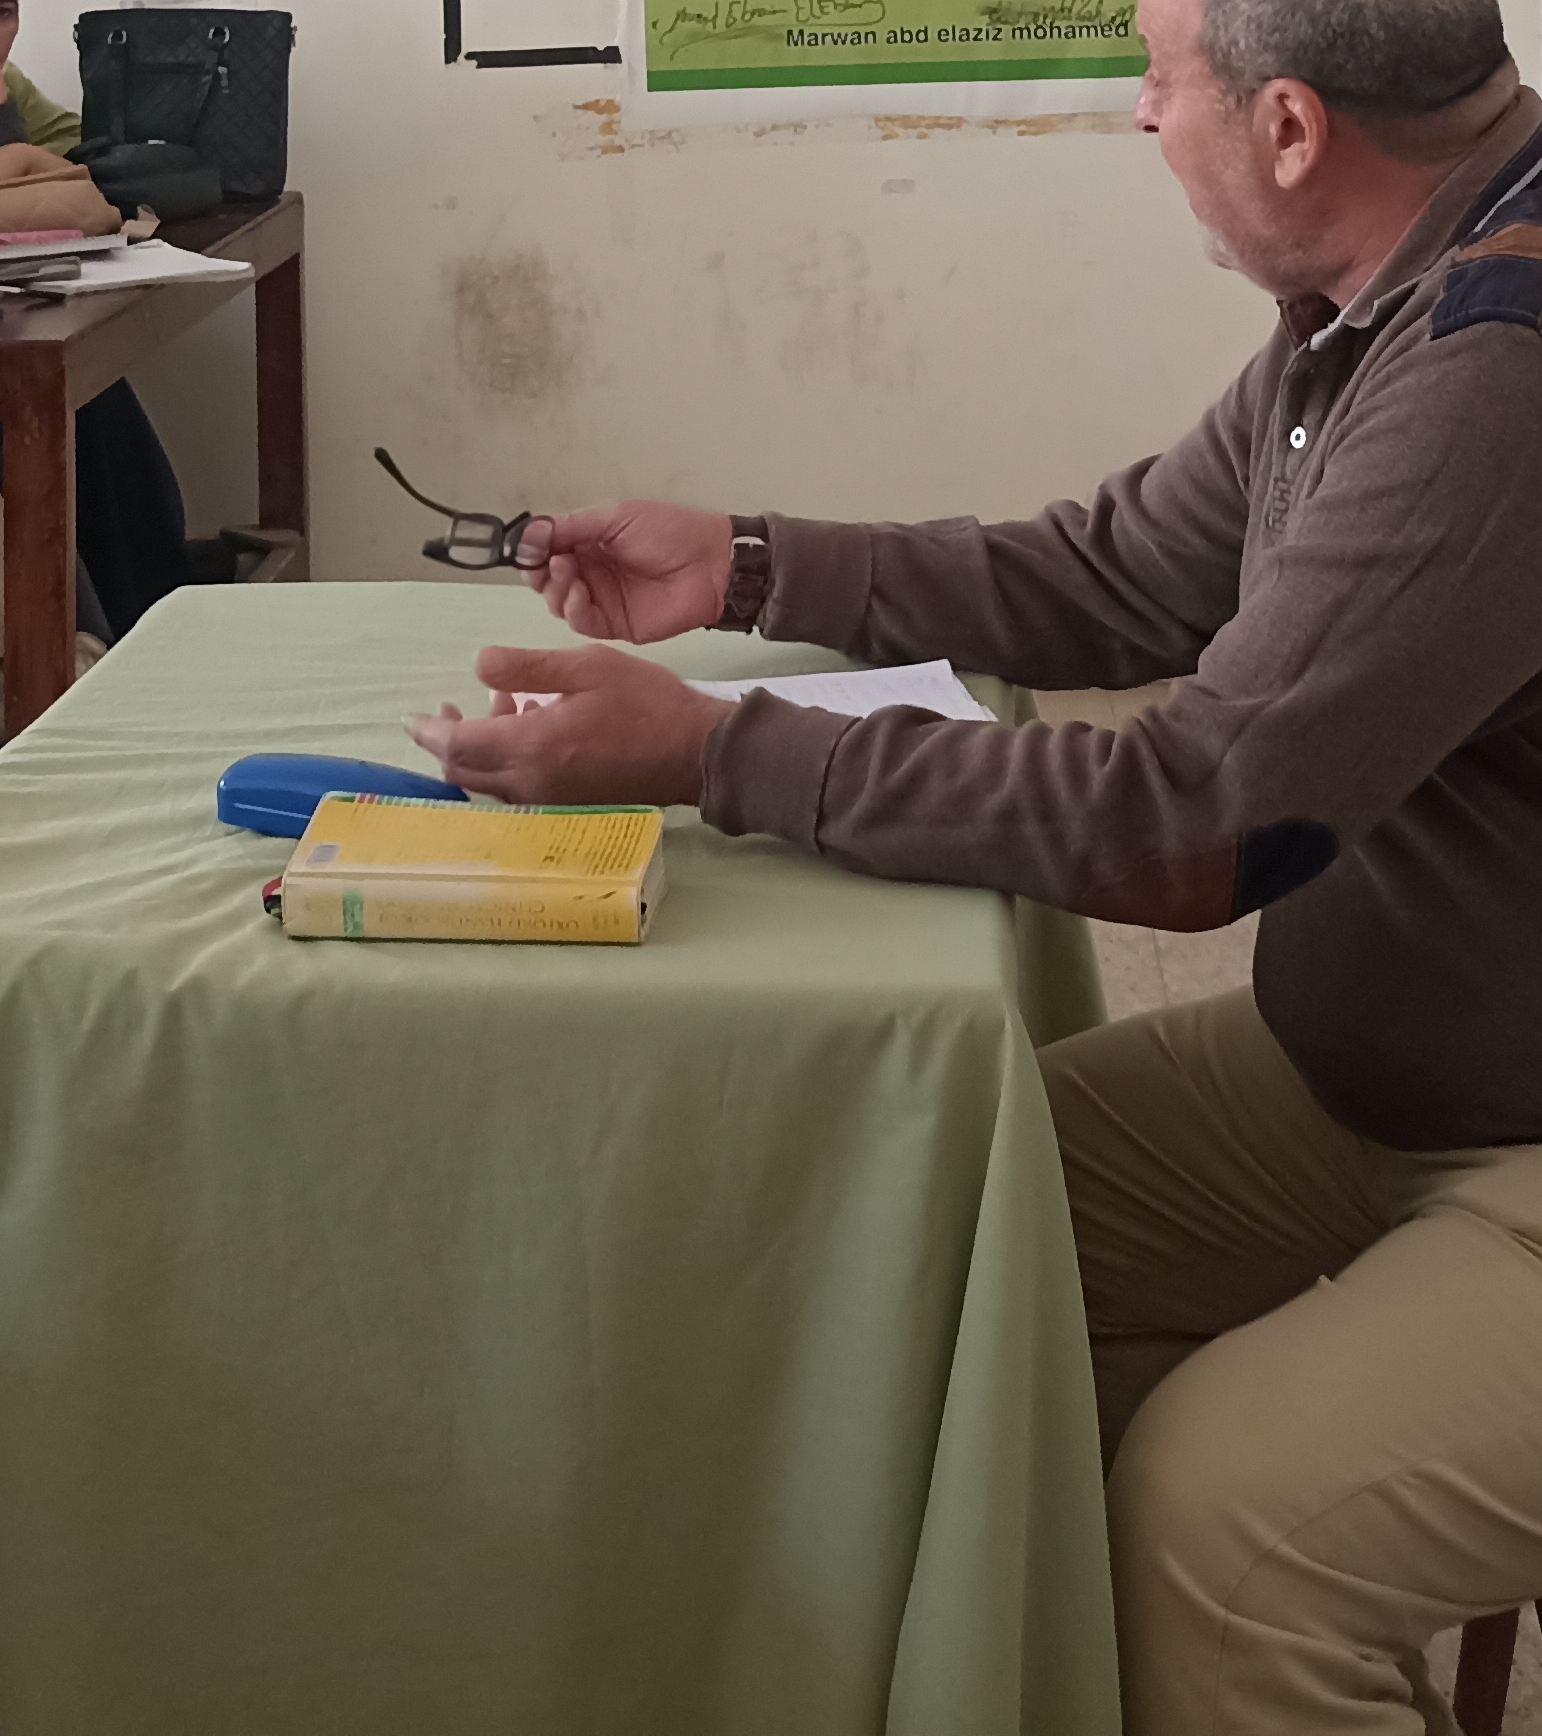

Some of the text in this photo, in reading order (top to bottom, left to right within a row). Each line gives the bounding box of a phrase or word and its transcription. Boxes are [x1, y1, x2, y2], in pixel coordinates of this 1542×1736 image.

[786, 20, 1130, 47] Marwan abd elaziz mohamed
